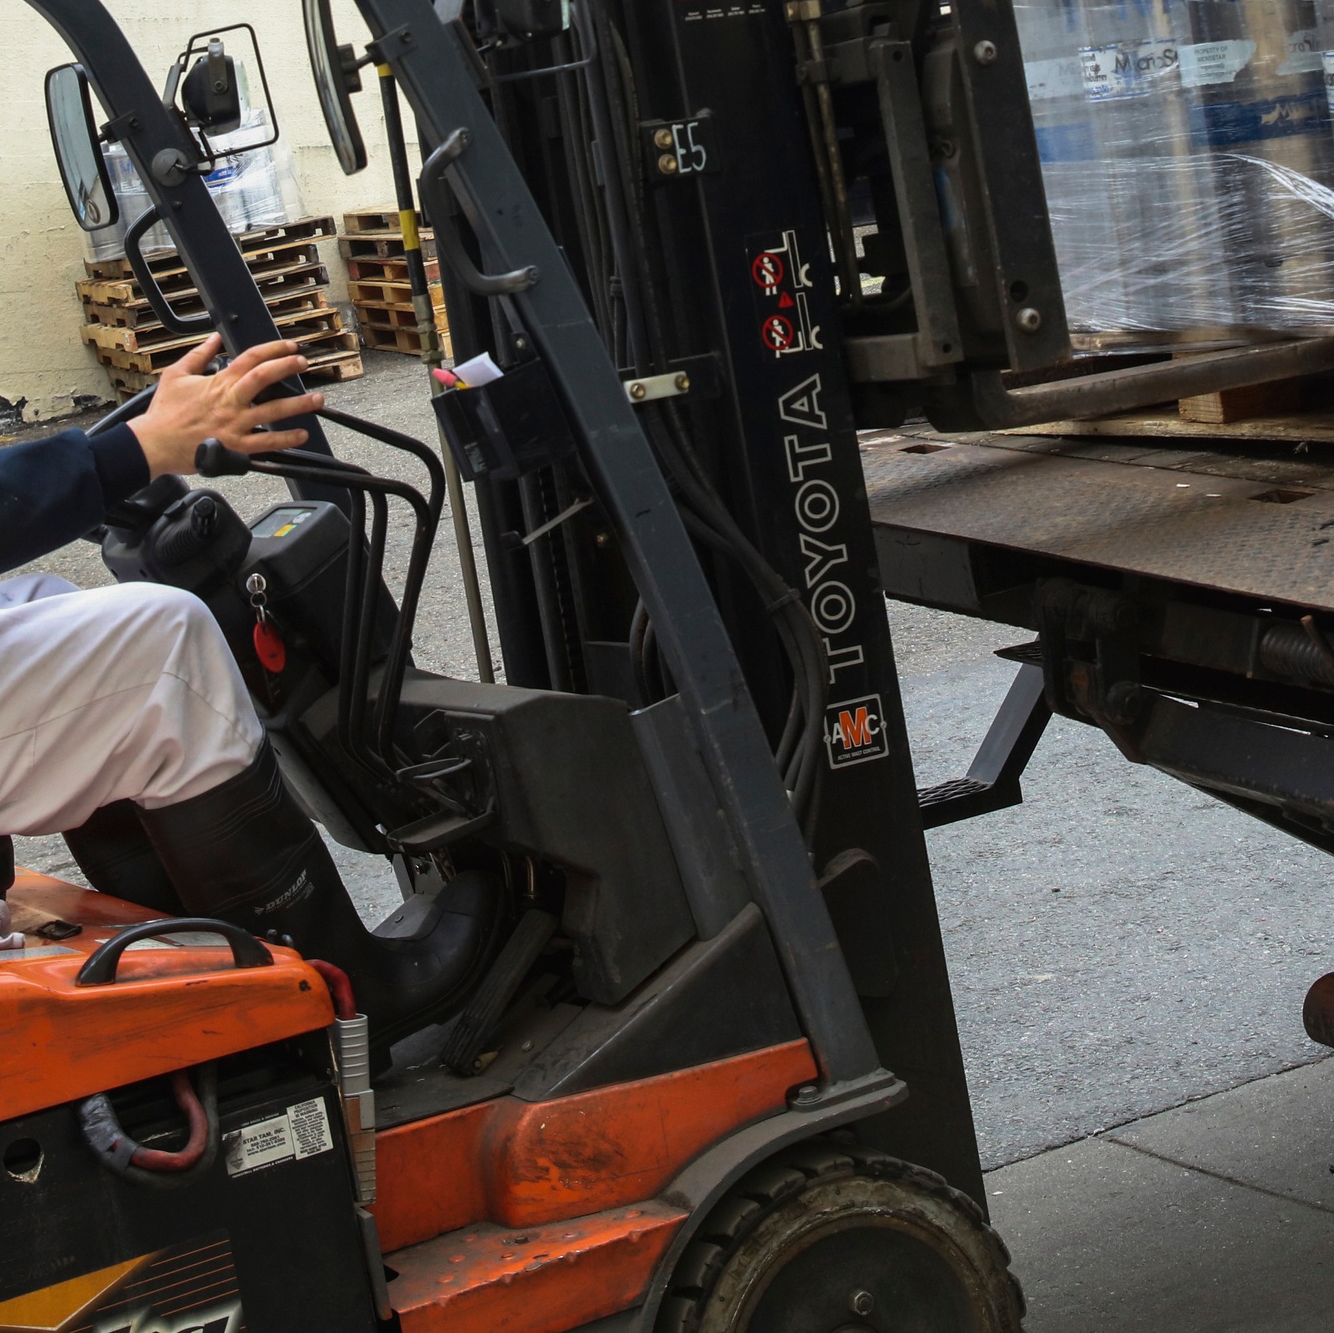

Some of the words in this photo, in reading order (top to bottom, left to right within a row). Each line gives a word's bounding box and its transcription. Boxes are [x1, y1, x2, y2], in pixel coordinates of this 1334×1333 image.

[670, 121, 708, 174] E5
[777, 372, 865, 686] TOYOTA
[832, 706, 881, 750] AMC
[265, 868, 307, 912] DUNLOP
[242, 1135, 259, 1145] STAR
[273, 1127, 286, 1135] INC.
